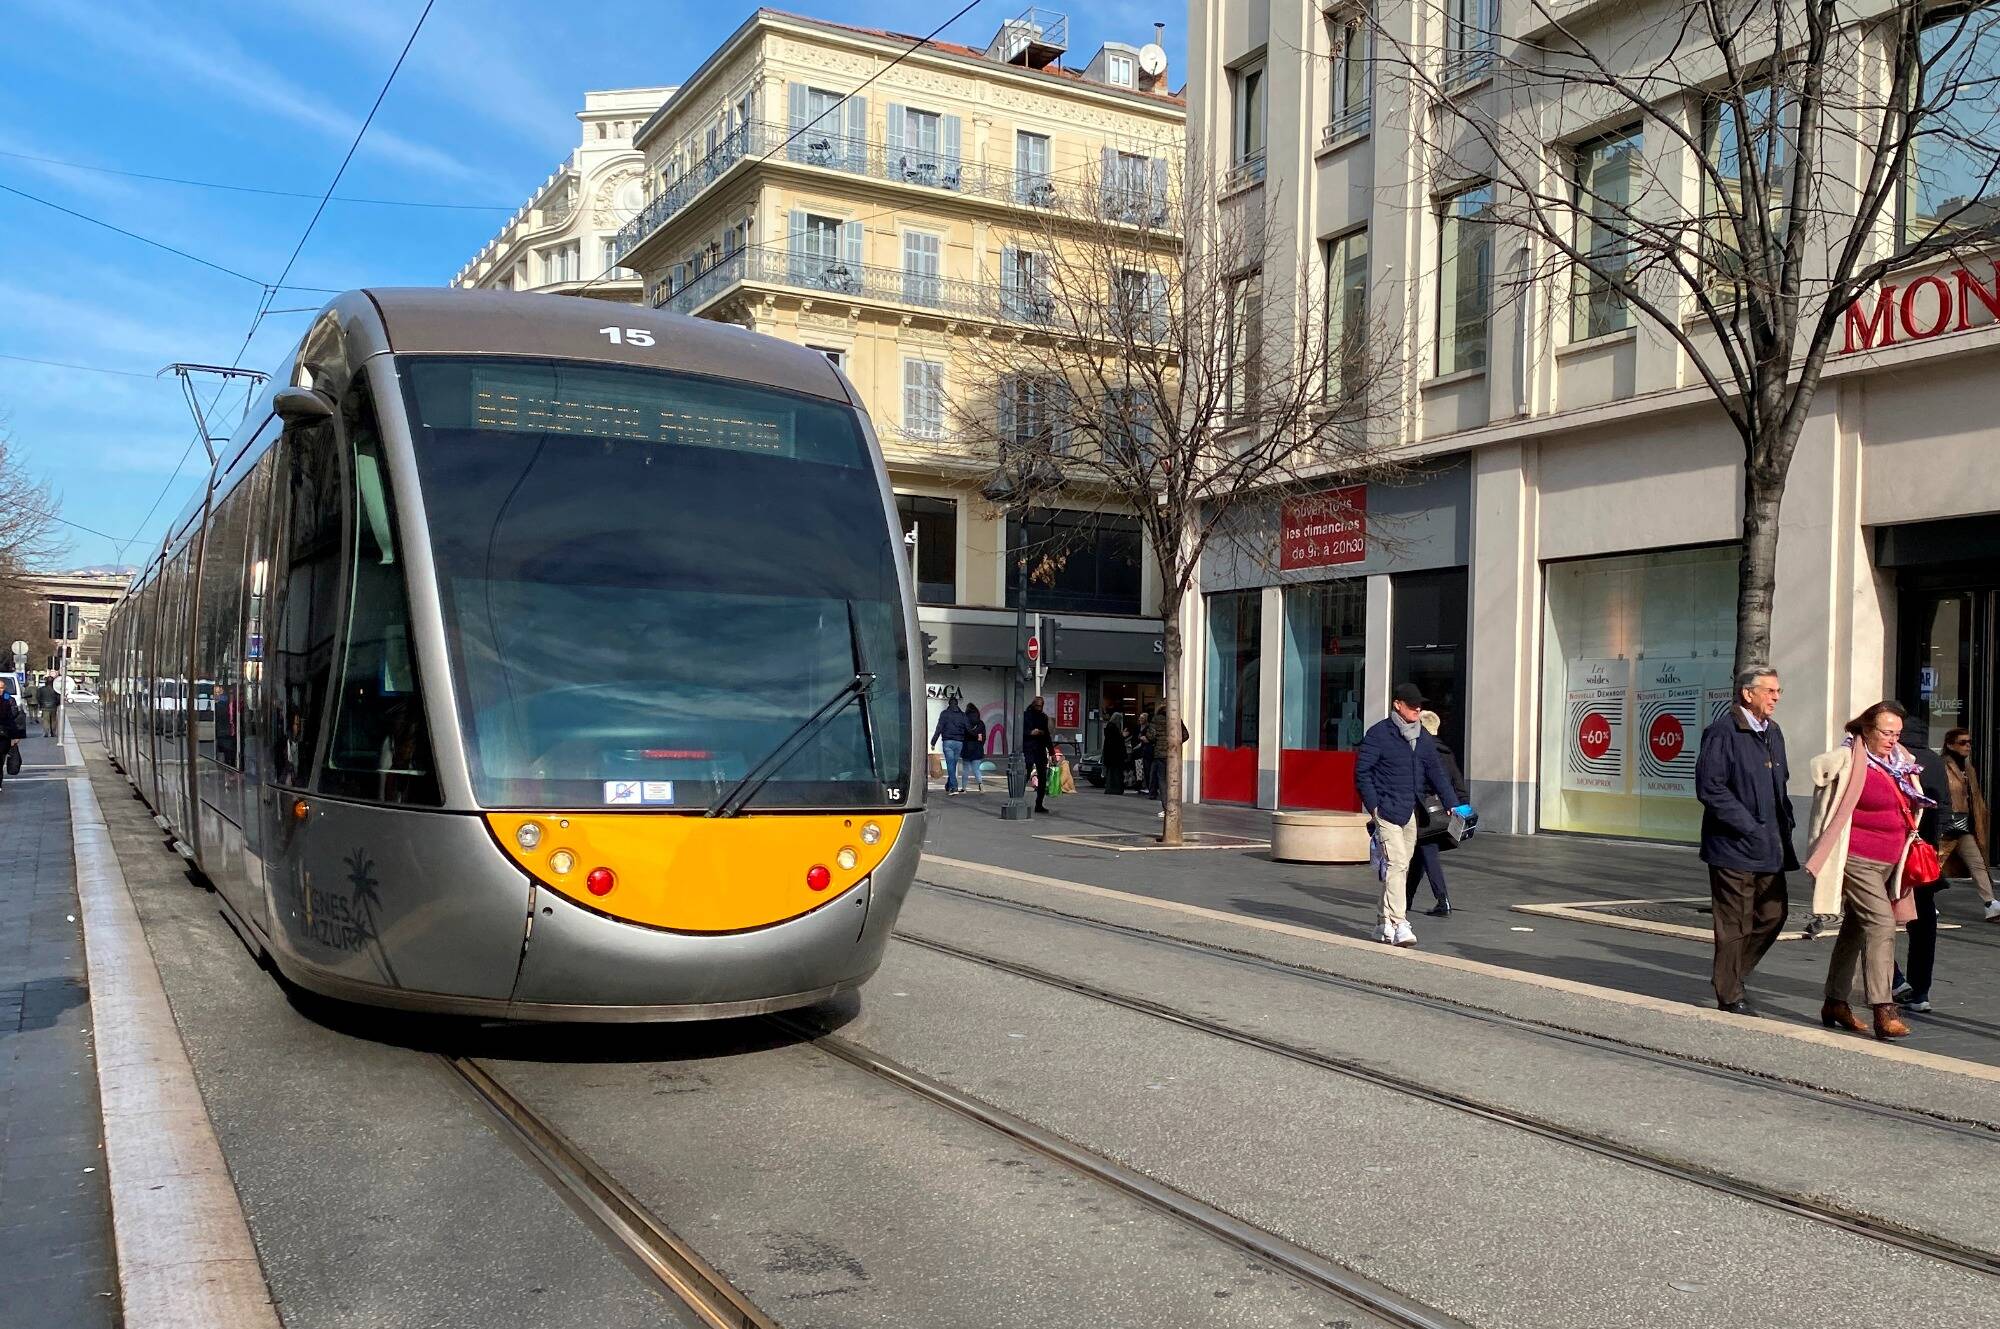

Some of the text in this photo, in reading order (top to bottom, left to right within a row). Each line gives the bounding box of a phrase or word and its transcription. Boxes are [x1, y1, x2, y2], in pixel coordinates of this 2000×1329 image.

[599, 326, 656, 347] 15
[1286, 520, 1360, 540] les dimanches
[1292, 546, 1305, 560] de
[1323, 541, 1330, 556] à
[1332, 538, 1364, 555] 20h30
[1661, 661, 1676, 673] Les
[1585, 674, 1610, 685] soldes
[1655, 673, 1681, 684] soldes
[927, 684, 963, 699] SAGA
[1929, 697, 1963, 709] ENTRÉE
[1582, 730, 1609, 744] -60%
[1653, 731, 1681, 746] -60%
[1577, 777, 1612, 788] MONOPRIX
[1648, 782, 1686, 792] MONOPRIX
[887, 788, 900, 800] 15
